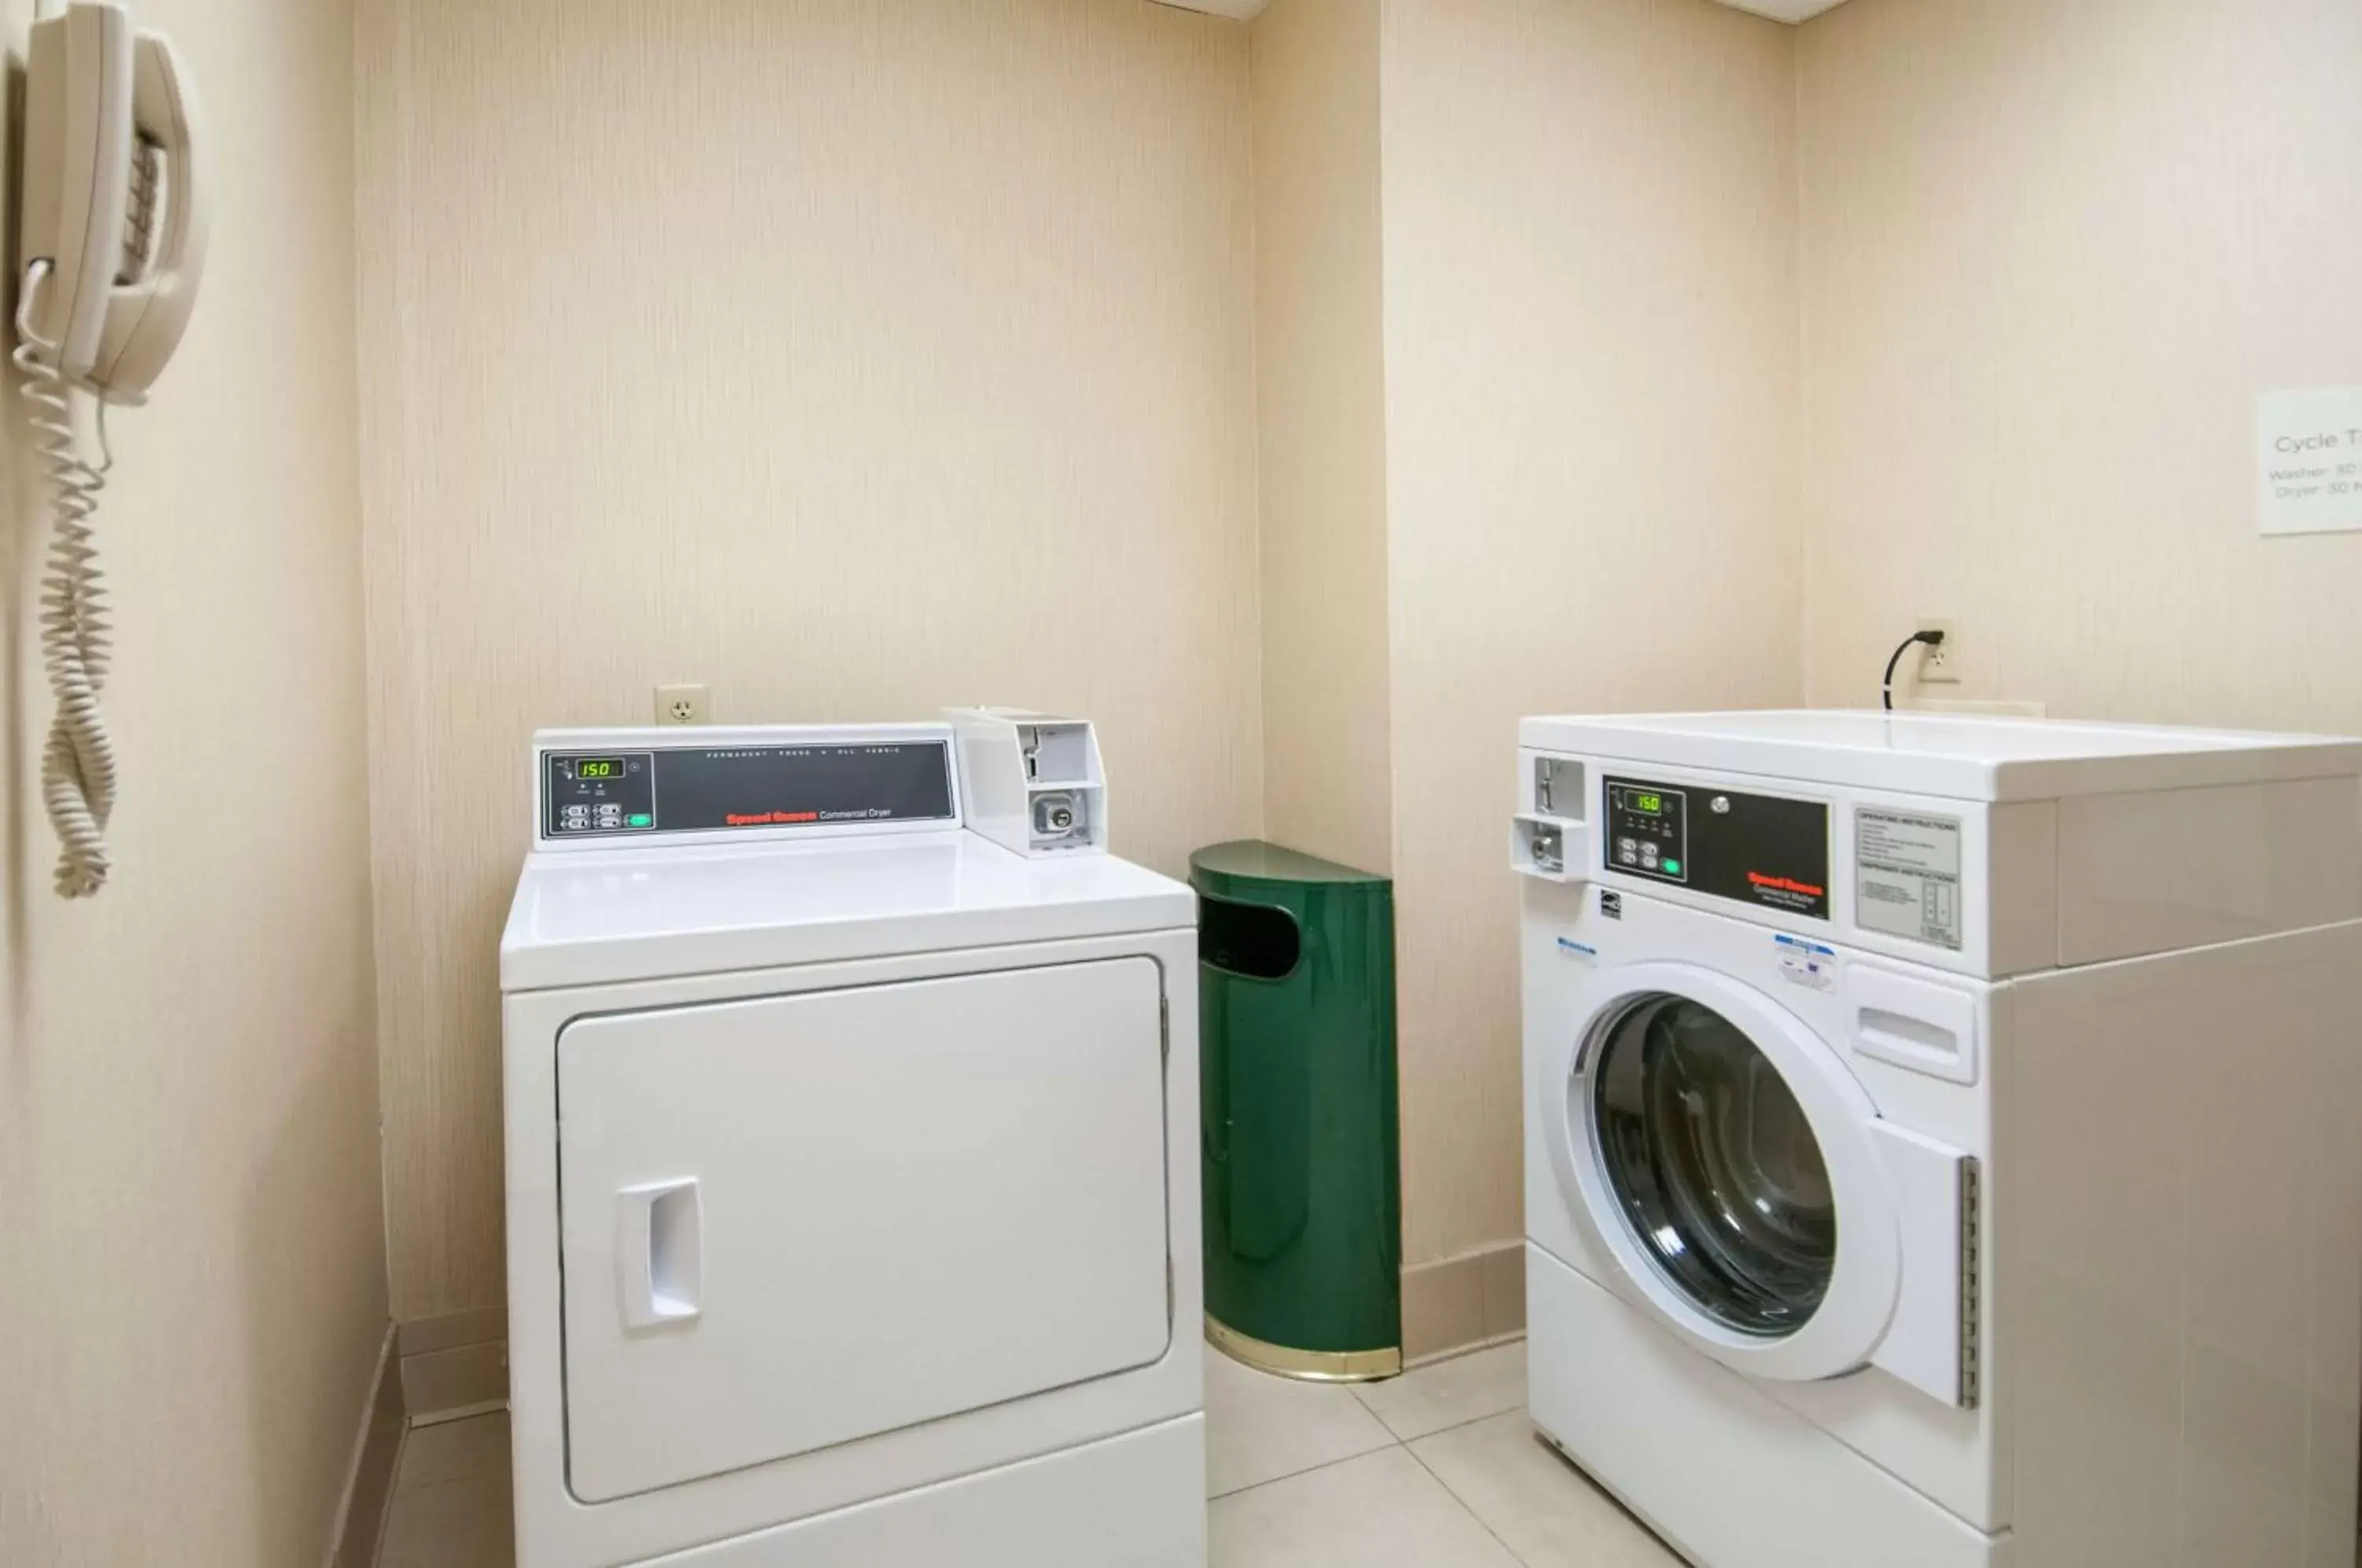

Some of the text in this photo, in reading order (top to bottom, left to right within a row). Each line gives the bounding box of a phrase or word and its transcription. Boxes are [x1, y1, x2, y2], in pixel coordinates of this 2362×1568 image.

[2275, 431, 2338, 453] Cycle
[583, 763, 609, 775] 150
[1638, 795, 1659, 810] 150
[819, 809, 867, 820] Commercial
[868, 808, 891, 819] Dryer
